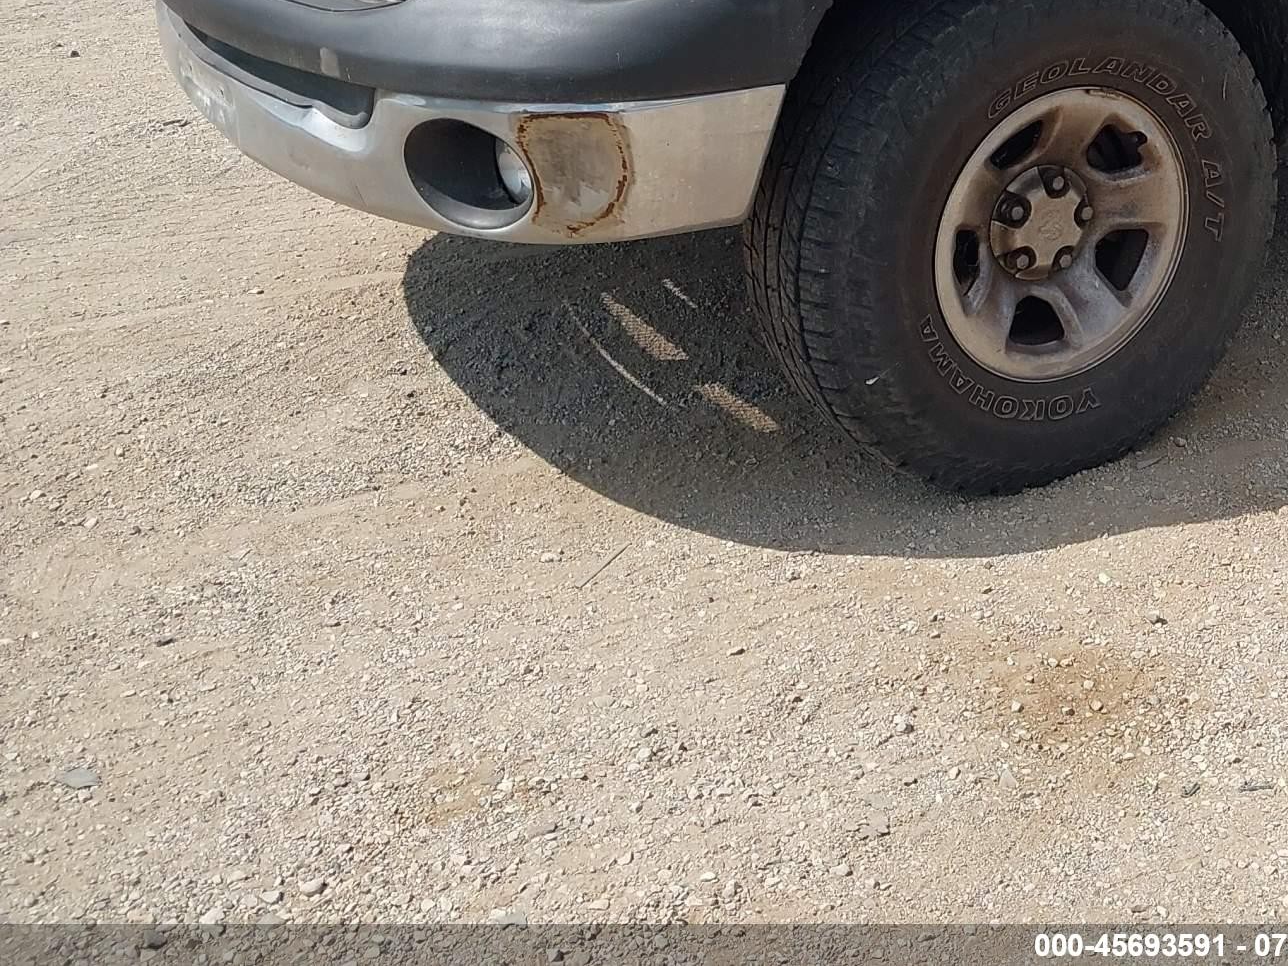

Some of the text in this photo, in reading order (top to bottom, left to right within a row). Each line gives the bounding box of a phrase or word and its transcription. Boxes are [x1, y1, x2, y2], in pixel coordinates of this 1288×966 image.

[988, 56, 1225, 242] GEOLANDAR A/T
[920, 313, 1102, 421] YOKOHAMA
